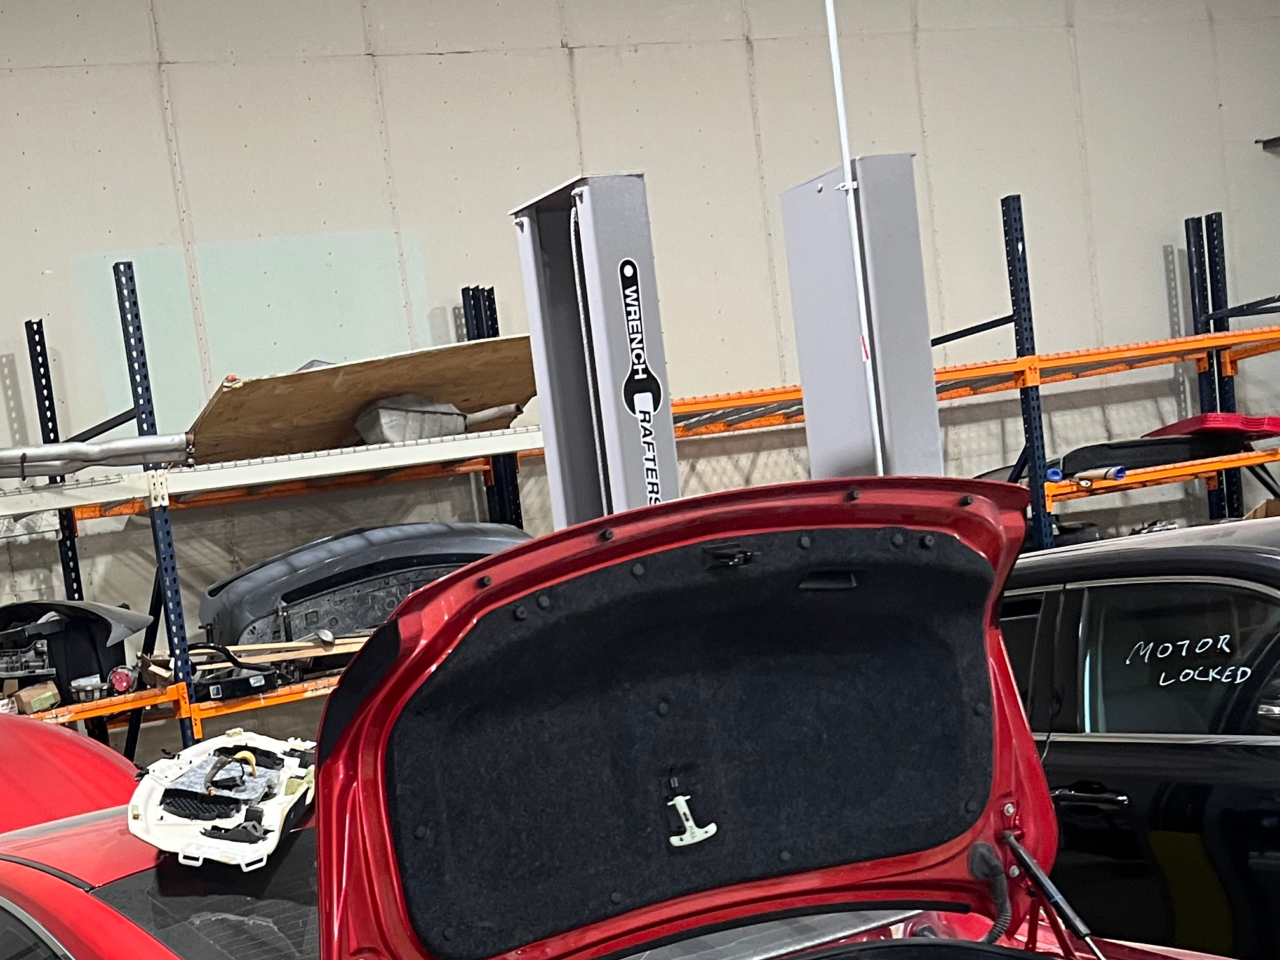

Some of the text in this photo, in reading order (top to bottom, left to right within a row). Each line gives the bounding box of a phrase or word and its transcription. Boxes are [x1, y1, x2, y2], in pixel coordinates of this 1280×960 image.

[624, 285, 648, 380] WRENCH
[1125, 634, 1231, 665] MOTOR
[1158, 666, 1252, 686] LOCKED
